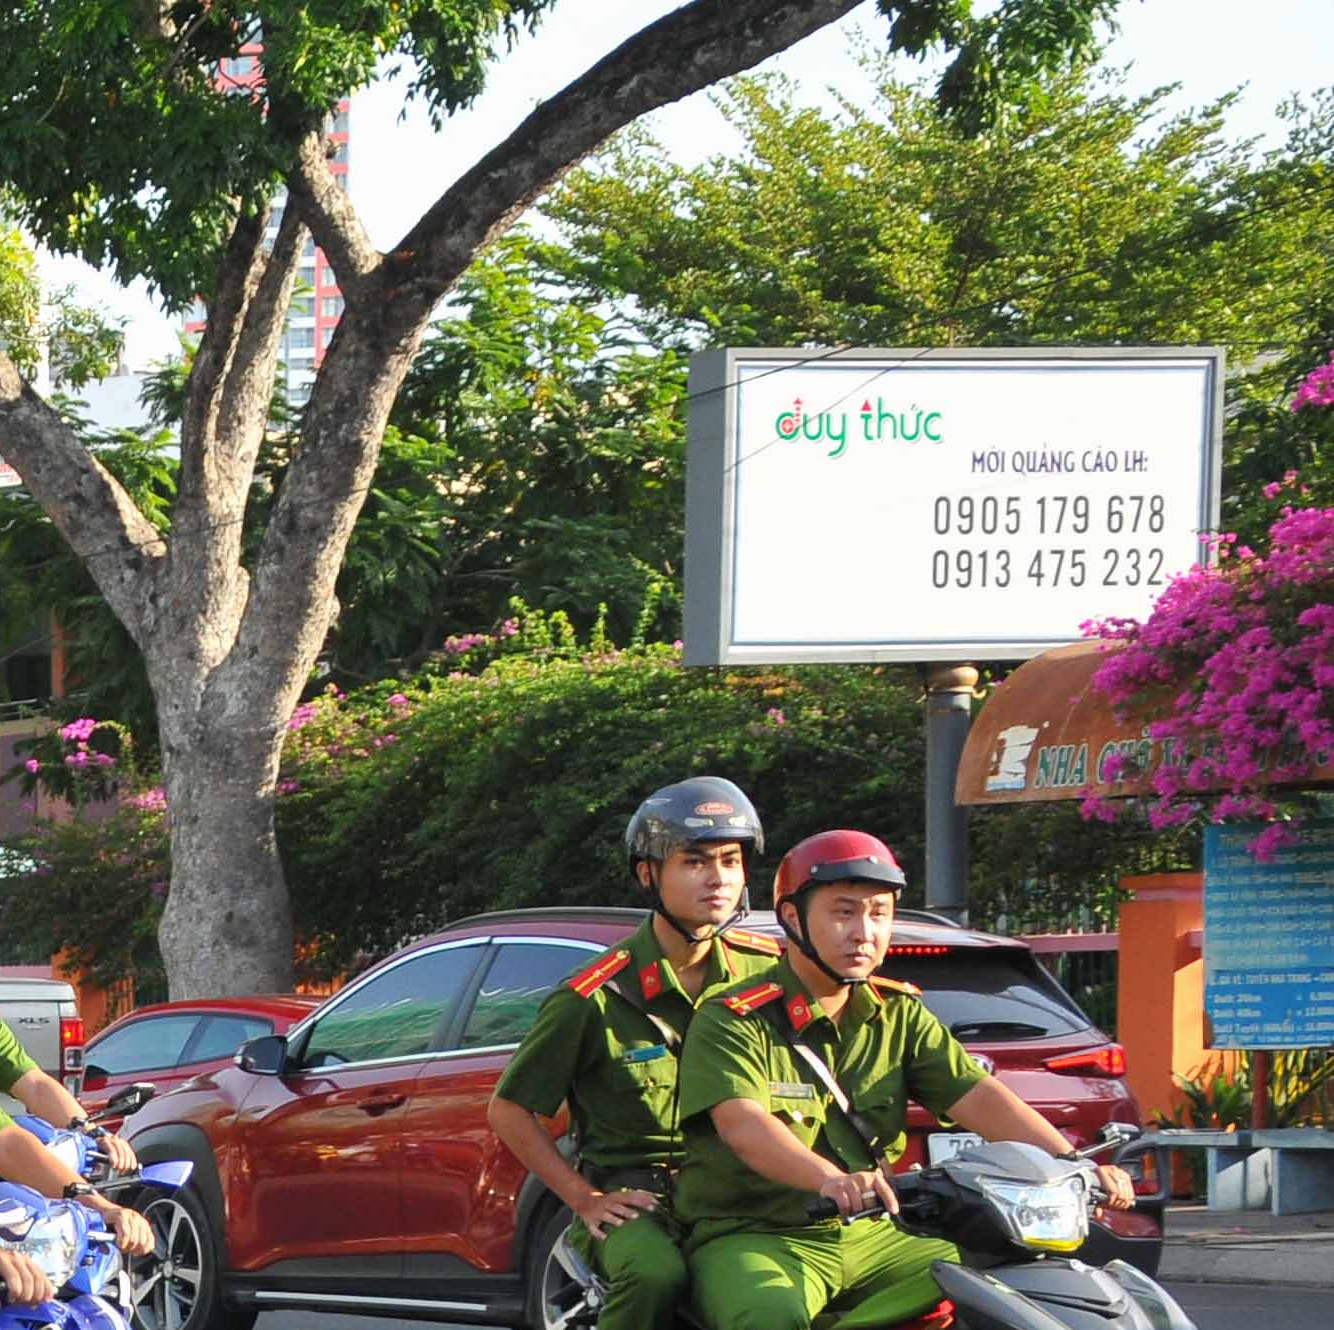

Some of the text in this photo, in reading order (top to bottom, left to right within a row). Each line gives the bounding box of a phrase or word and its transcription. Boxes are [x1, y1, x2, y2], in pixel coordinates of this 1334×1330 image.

[775, 396, 942, 457] duy thức
[1124, 450, 1149, 473] LH:
[934, 494, 1165, 535] 0905 179 678
[932, 547, 1164, 589] 0913 475 232
[18, 1016, 50, 1024] XLS
